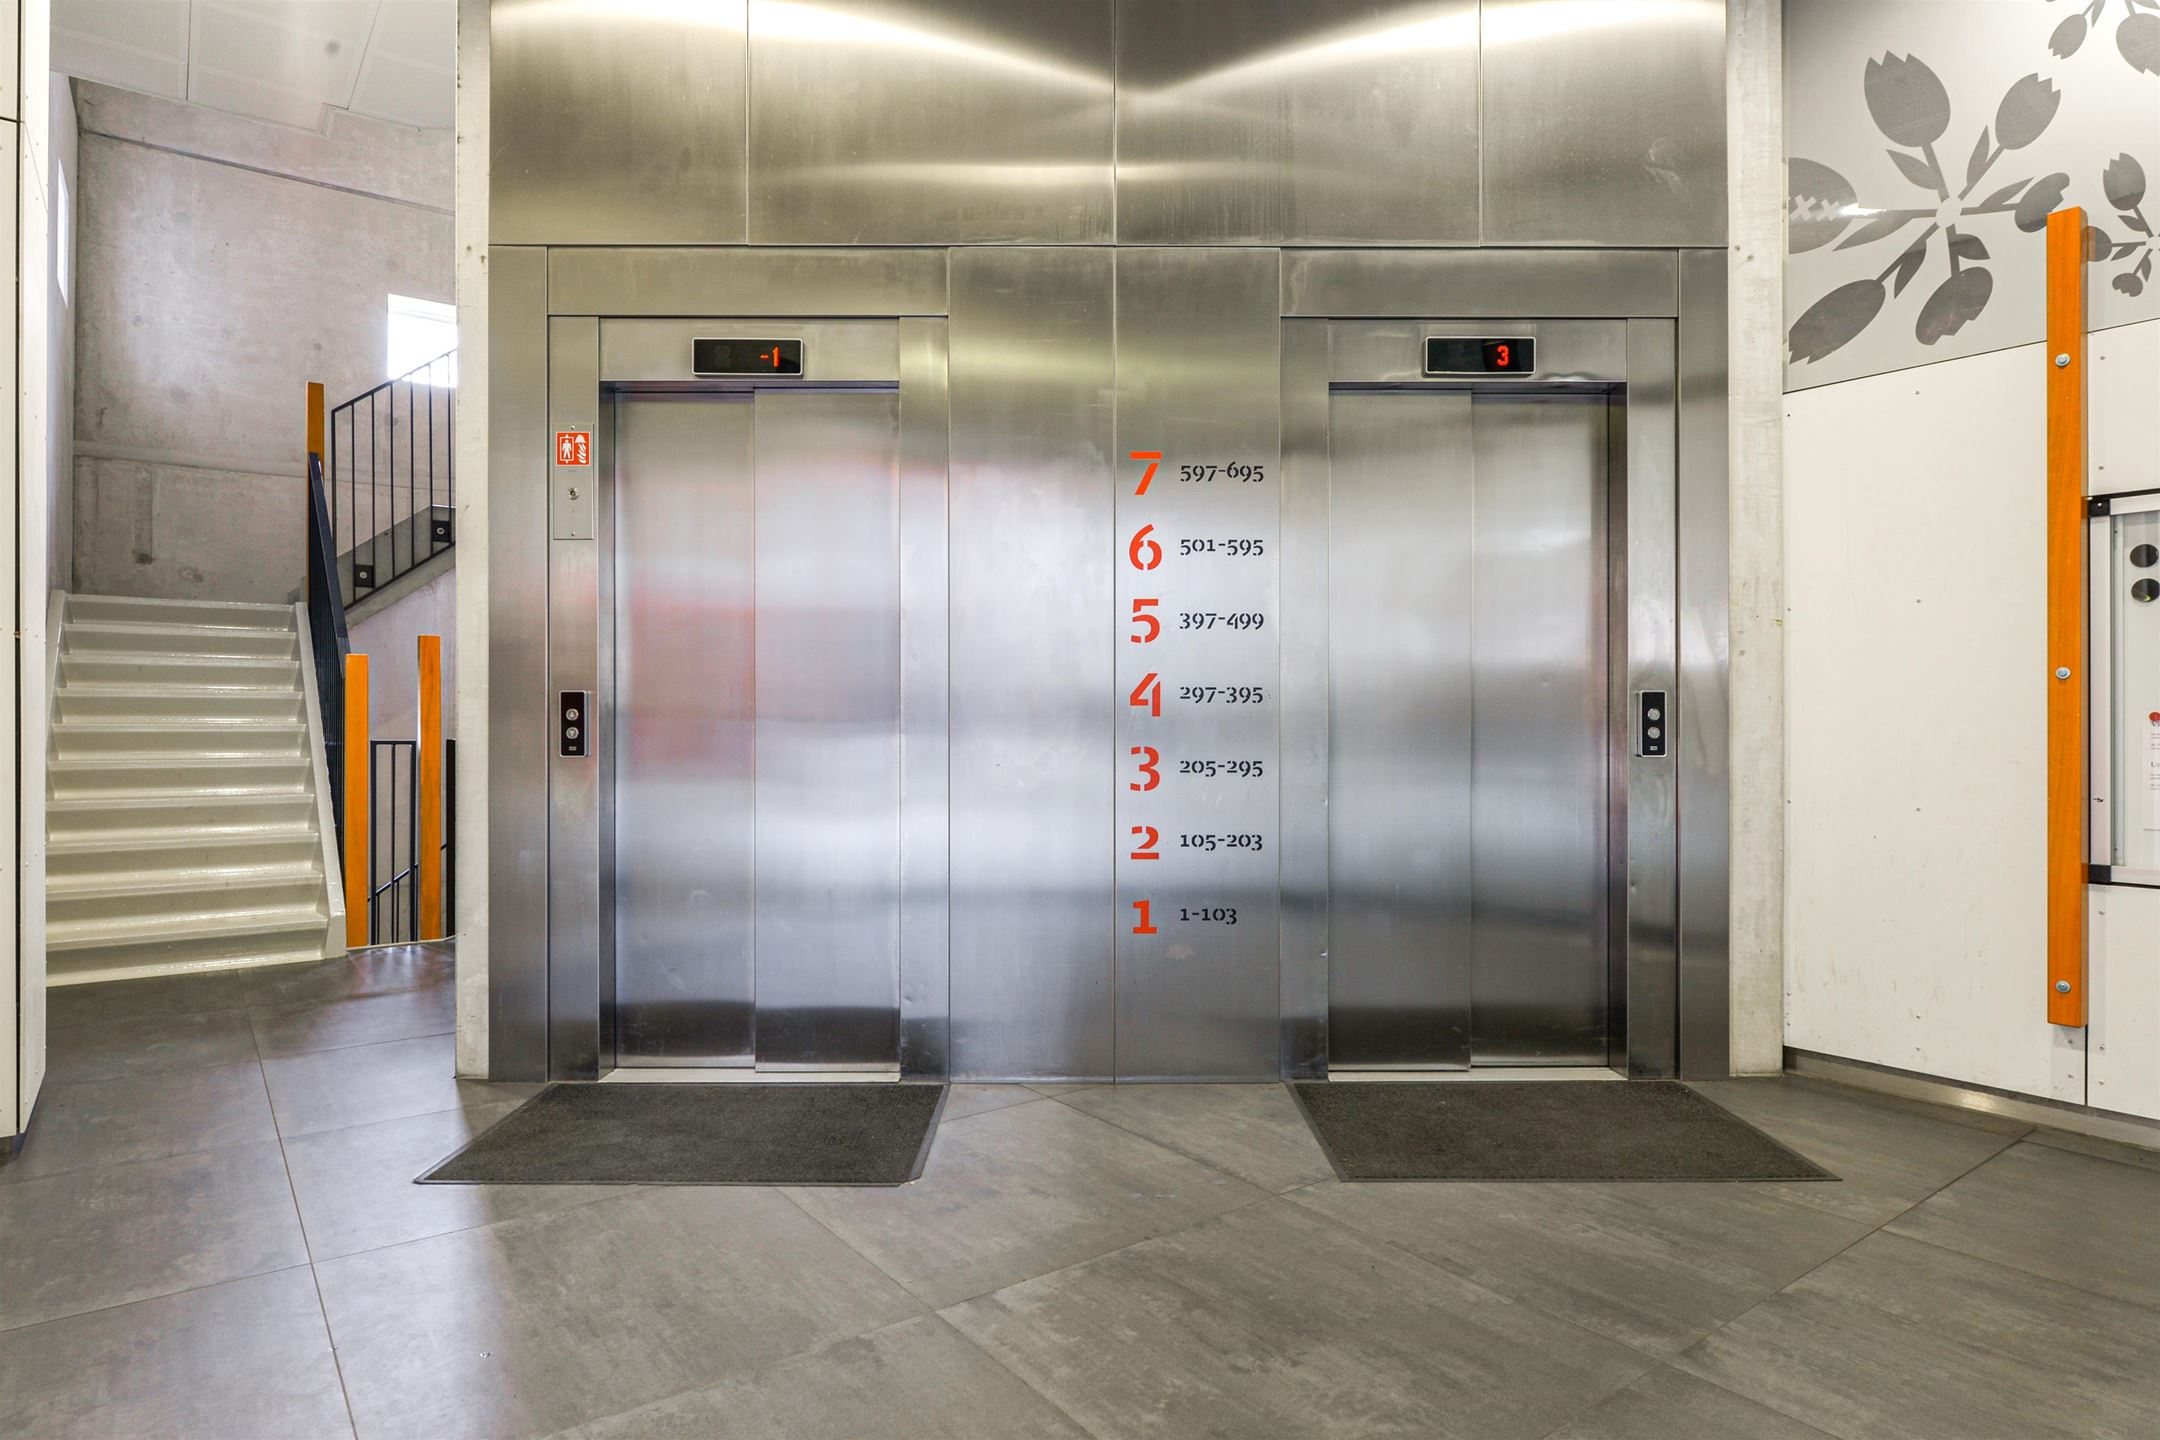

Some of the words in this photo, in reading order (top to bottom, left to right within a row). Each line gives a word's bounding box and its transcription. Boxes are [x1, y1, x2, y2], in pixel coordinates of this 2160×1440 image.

[760, 346, 780, 368] -1
[1497, 346, 1509, 367] 3
[1130, 451, 1162, 495] 7
[1180, 461, 1264, 482] 597-695
[1129, 524, 1162, 570] 6
[1180, 539, 1264, 556] 501-595
[1131, 598, 1160, 643] 5
[1180, 613, 1264, 630] 397-499
[1130, 673, 1161, 717] 4
[1180, 686, 1264, 704] 297-395
[1130, 746, 1160, 791] 3
[1180, 760, 1263, 778] 205-295
[1131, 826, 1159, 860] 2
[1180, 834, 1263, 851] 105-203
[1133, 900, 1157, 934] 1
[1180, 908, 1238, 925] 1-103
